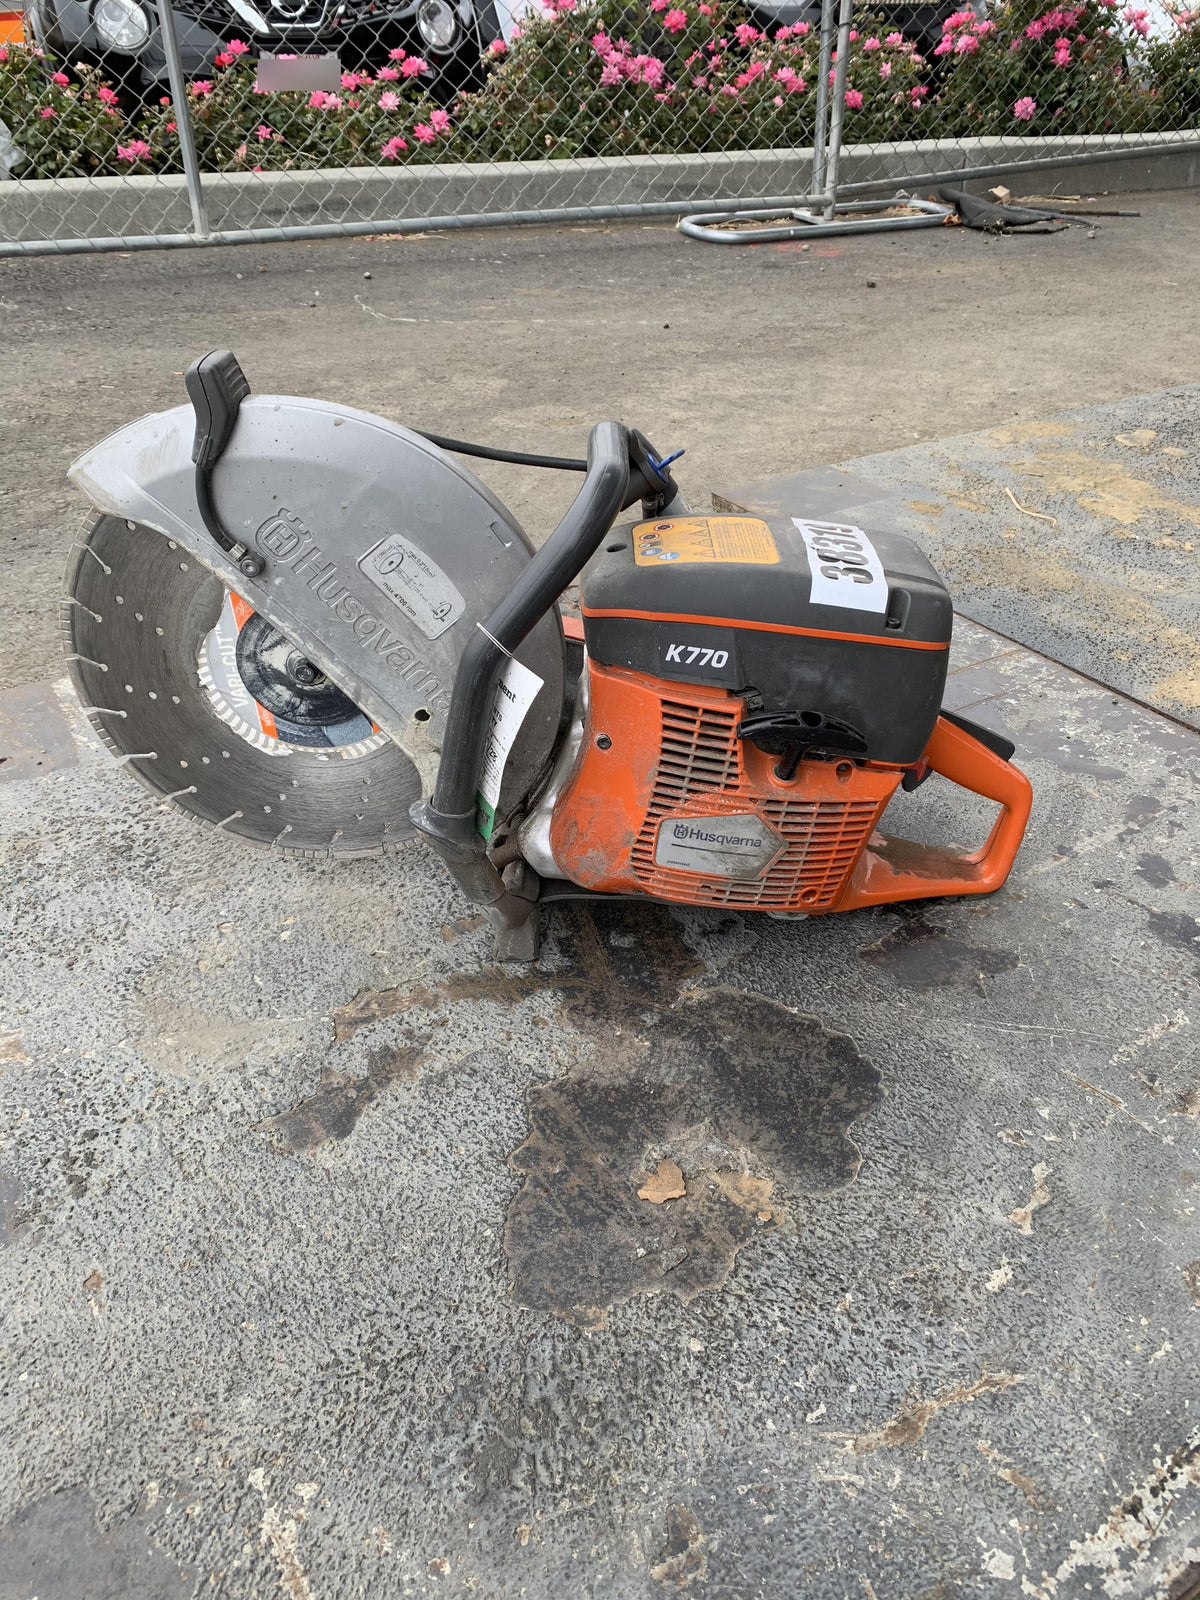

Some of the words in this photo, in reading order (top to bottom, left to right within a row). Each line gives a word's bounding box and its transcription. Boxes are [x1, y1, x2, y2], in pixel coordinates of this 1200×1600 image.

[383, 582, 394, 594] max
[290, 545, 453, 718] Husqvarna
[664, 643, 729, 669] K770
[688, 828, 762, 847] Husqvarna
